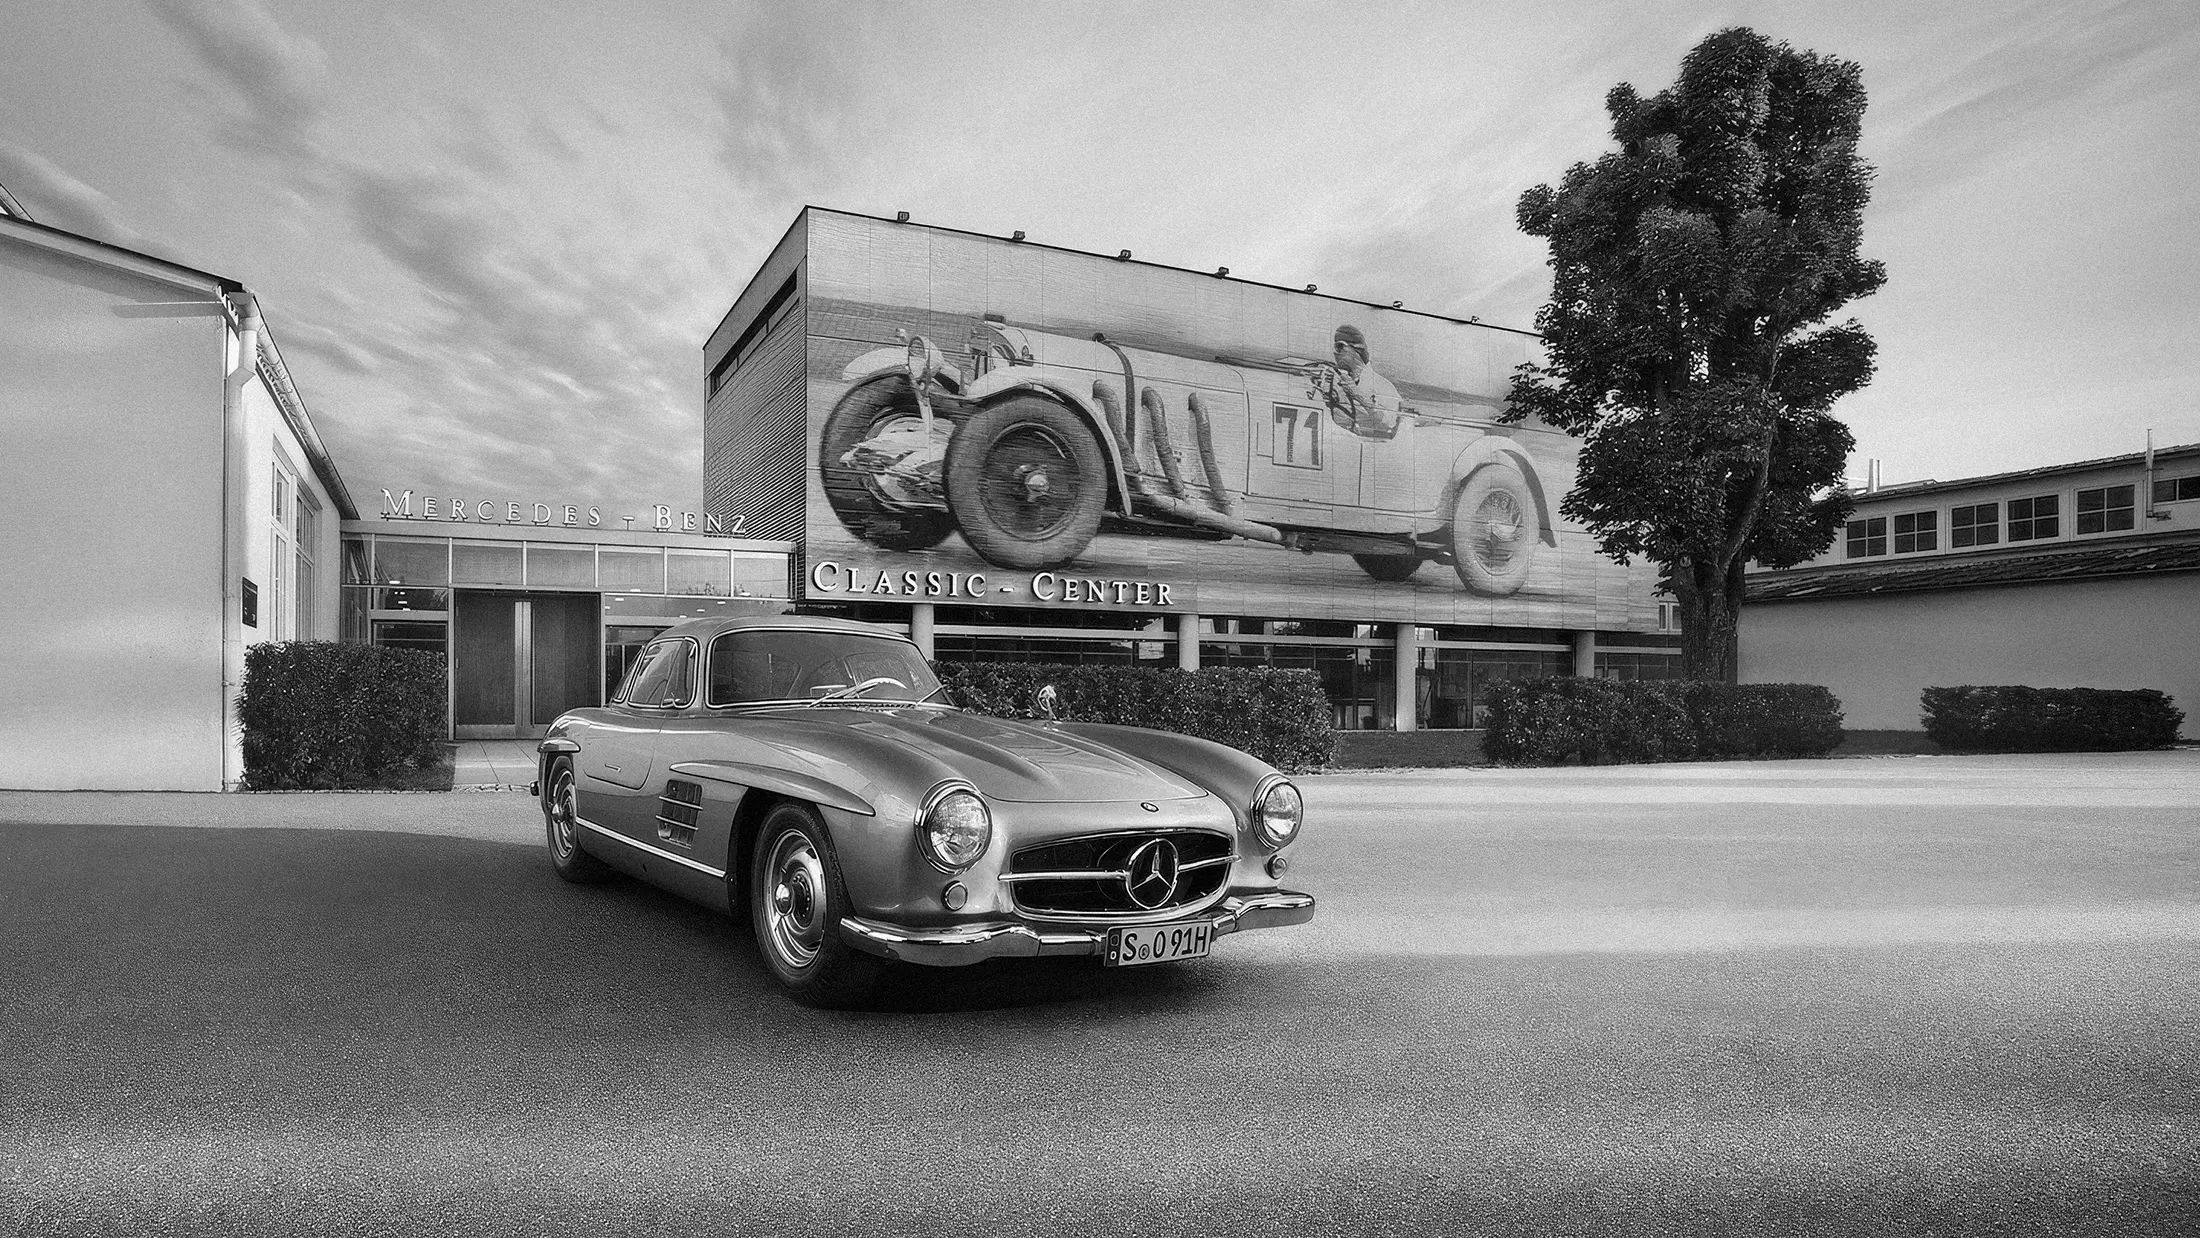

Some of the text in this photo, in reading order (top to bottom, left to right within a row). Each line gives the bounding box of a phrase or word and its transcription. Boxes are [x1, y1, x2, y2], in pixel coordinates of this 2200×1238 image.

[1275, 406, 1319, 466] 71
[381, 488, 601, 527] MERCEDES
[653, 504, 747, 535] BENZ
[812, 561, 987, 598] CLASSIC
[1032, 571, 1173, 605] CENTER
